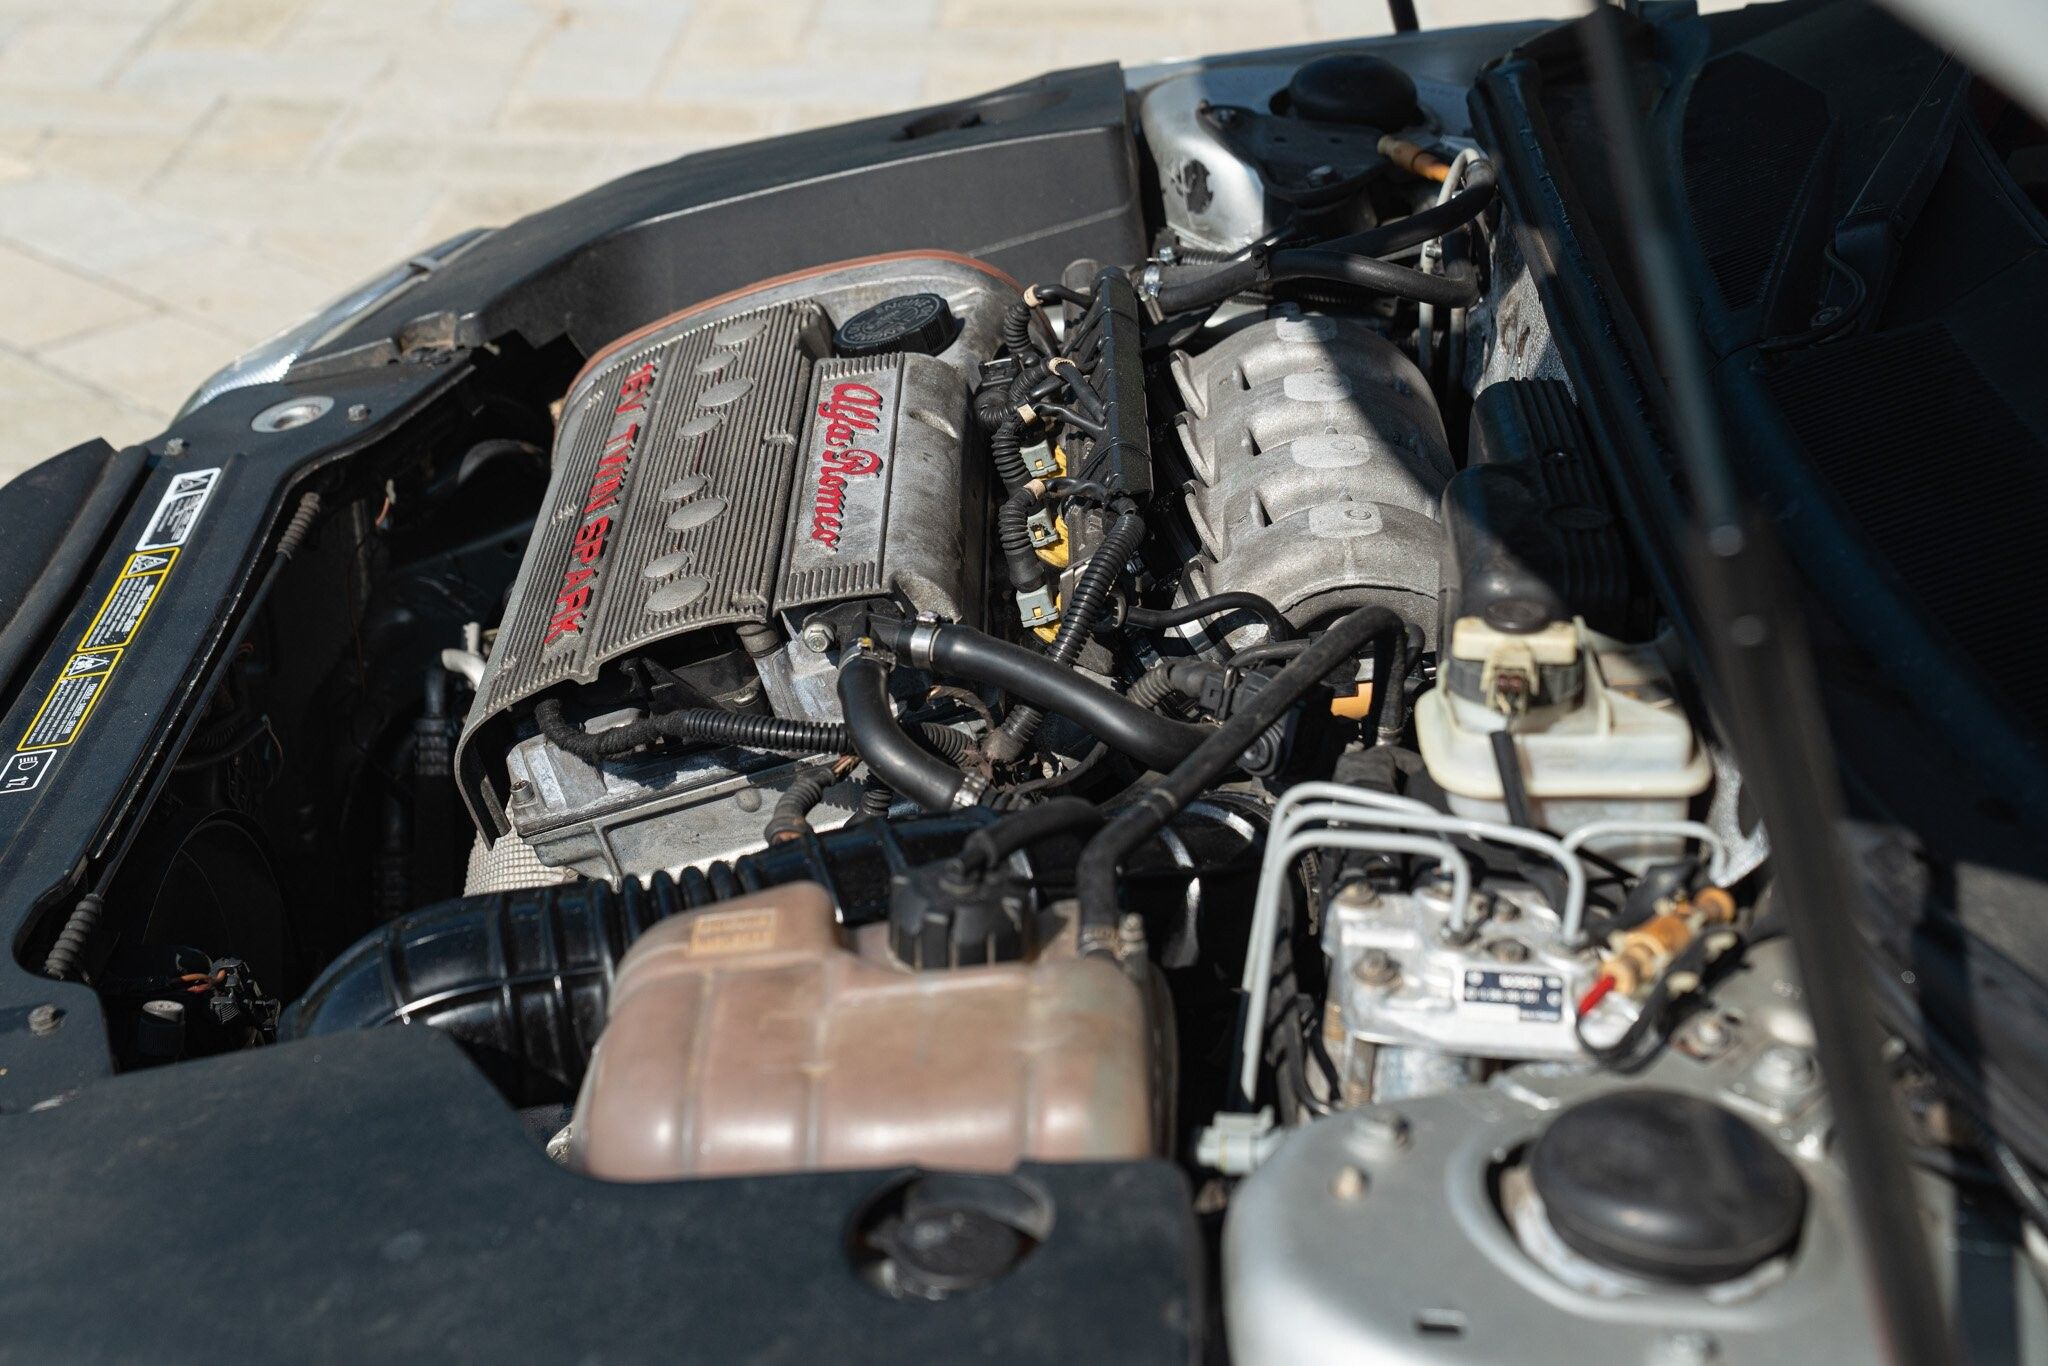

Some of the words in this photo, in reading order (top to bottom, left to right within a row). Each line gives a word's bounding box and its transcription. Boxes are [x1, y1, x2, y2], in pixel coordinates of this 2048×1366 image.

[615, 363, 655, 414] 16V
[818, 383, 883, 447] Alfa
[583, 423, 637, 514] TWIN
[811, 450, 883, 548] Romeo
[542, 515, 610, 645] SPARK
